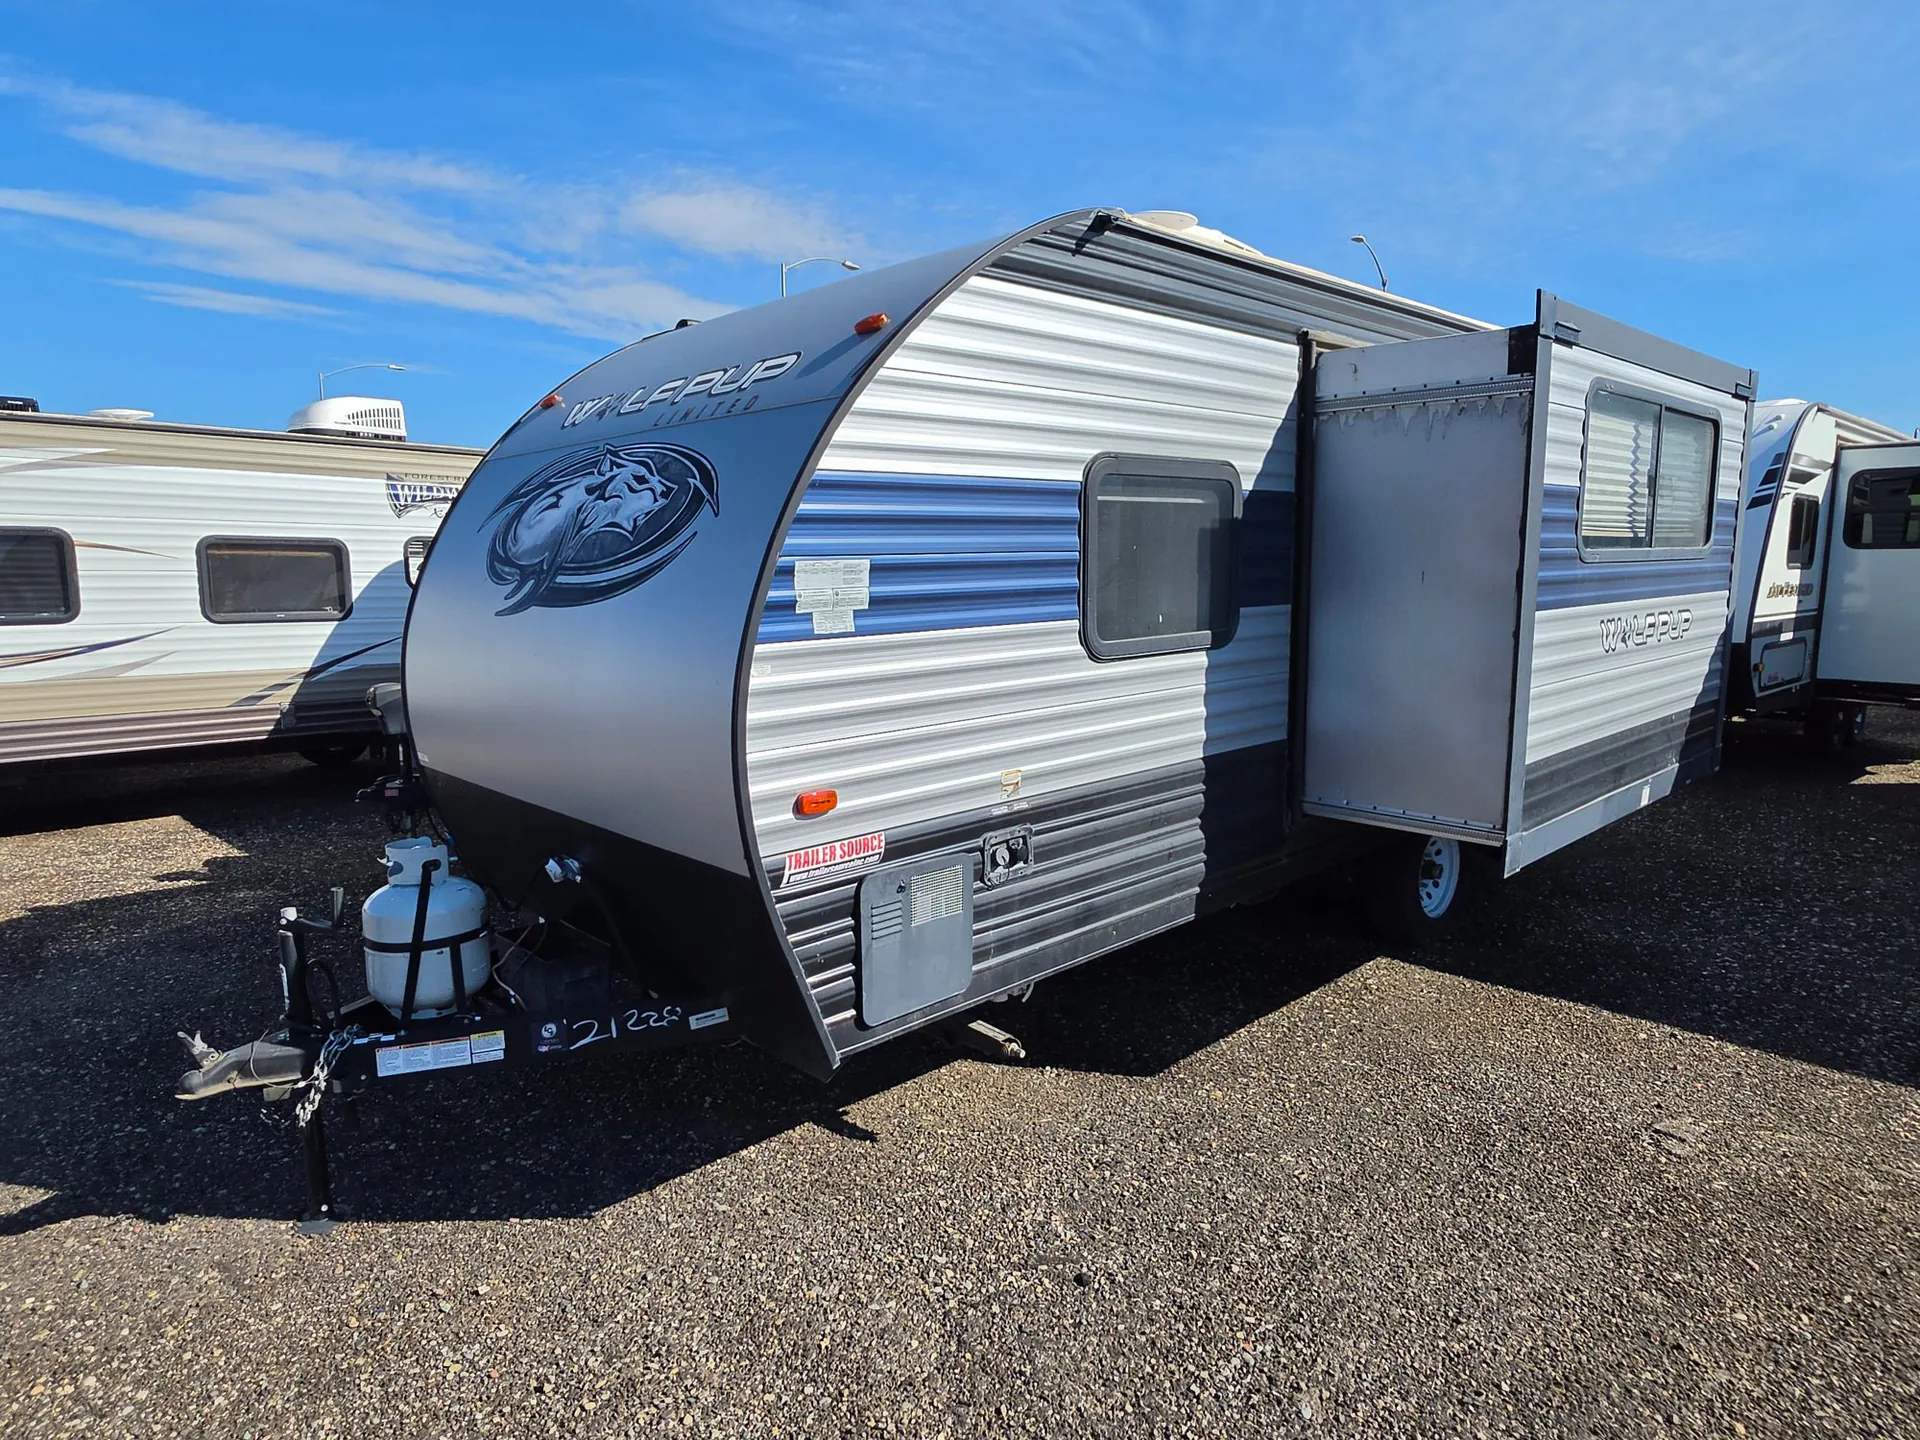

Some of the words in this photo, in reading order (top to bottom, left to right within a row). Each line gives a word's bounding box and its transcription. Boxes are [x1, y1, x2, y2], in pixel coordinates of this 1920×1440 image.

[653, 395, 760, 427] LIMITED
[404, 472, 453, 481] FOREST
[787, 844, 837, 872] TRAILER
[840, 833, 883, 859] SOURCE
